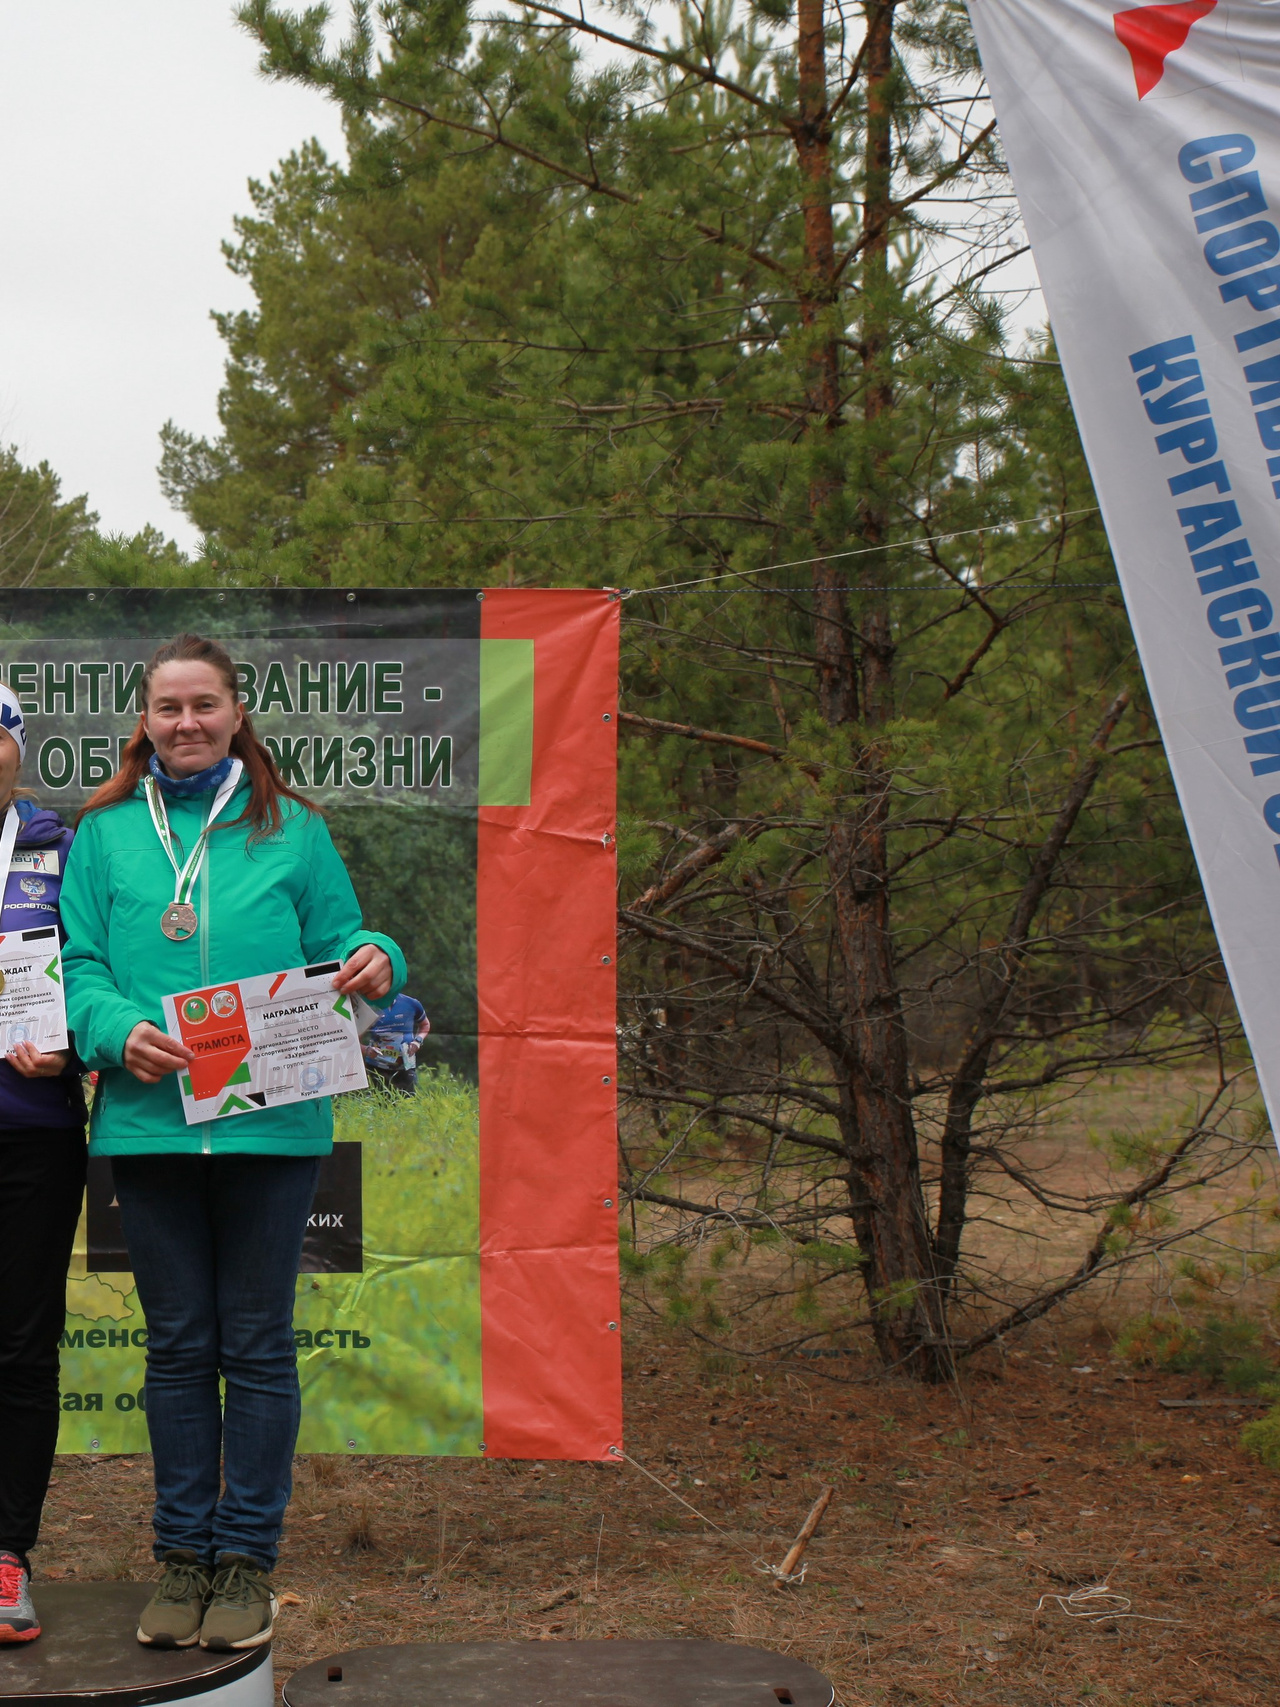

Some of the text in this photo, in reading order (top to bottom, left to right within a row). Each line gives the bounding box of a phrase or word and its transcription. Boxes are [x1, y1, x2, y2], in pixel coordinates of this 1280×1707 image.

[264, 735, 453, 788] ЖИЗНИ
[1, 965, 32, 975] ЖДАЕТ
[10, 998, 55, 1009] ориентированию
[11, 992, 52, 1001] соревнованиях
[263, 1003, 318, 1020] НАГРАЖДАЕТ
[297, 1025, 318, 1033] место
[190, 1034, 245, 1052] ГРАМОТА
[259, 1038, 299, 1051] региональных
[300, 1029, 343, 1041] соревнованиях
[261, 1045, 298, 1057] спортивному
[299, 1036, 347, 1049] ориентированию
[282, 1061, 304, 1070] группе
[294, 1329, 371, 1348] асть
